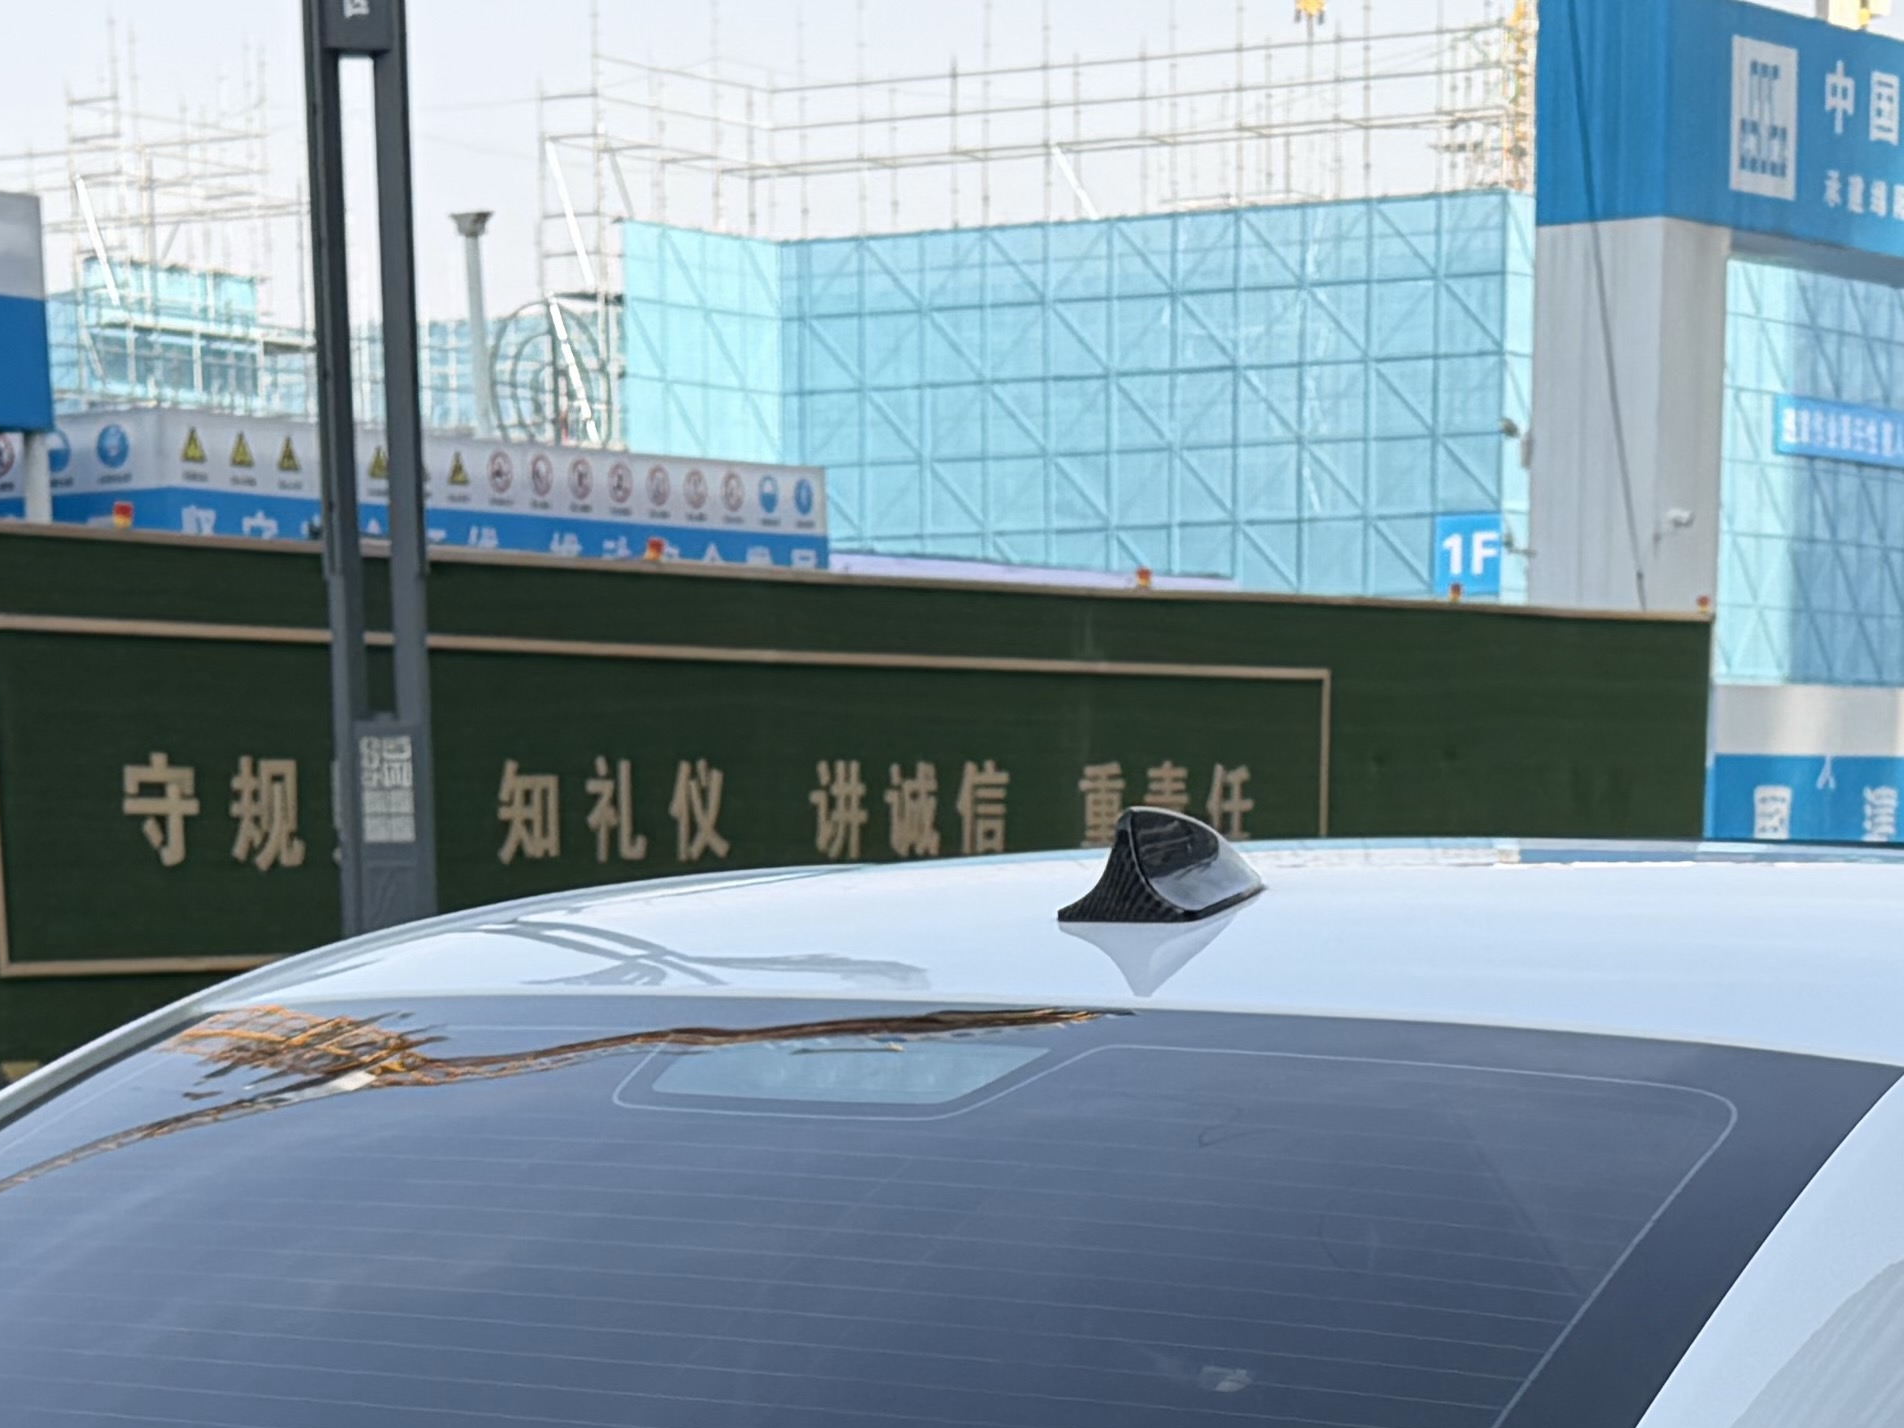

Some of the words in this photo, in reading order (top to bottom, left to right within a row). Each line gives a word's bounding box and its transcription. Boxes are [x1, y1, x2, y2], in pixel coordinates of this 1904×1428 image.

[1442, 530, 1499, 576] 1F
[123, 751, 343, 872] 守规
[498, 755, 731, 864] 知礼仪
[809, 759, 1010, 859] 讲诚信
